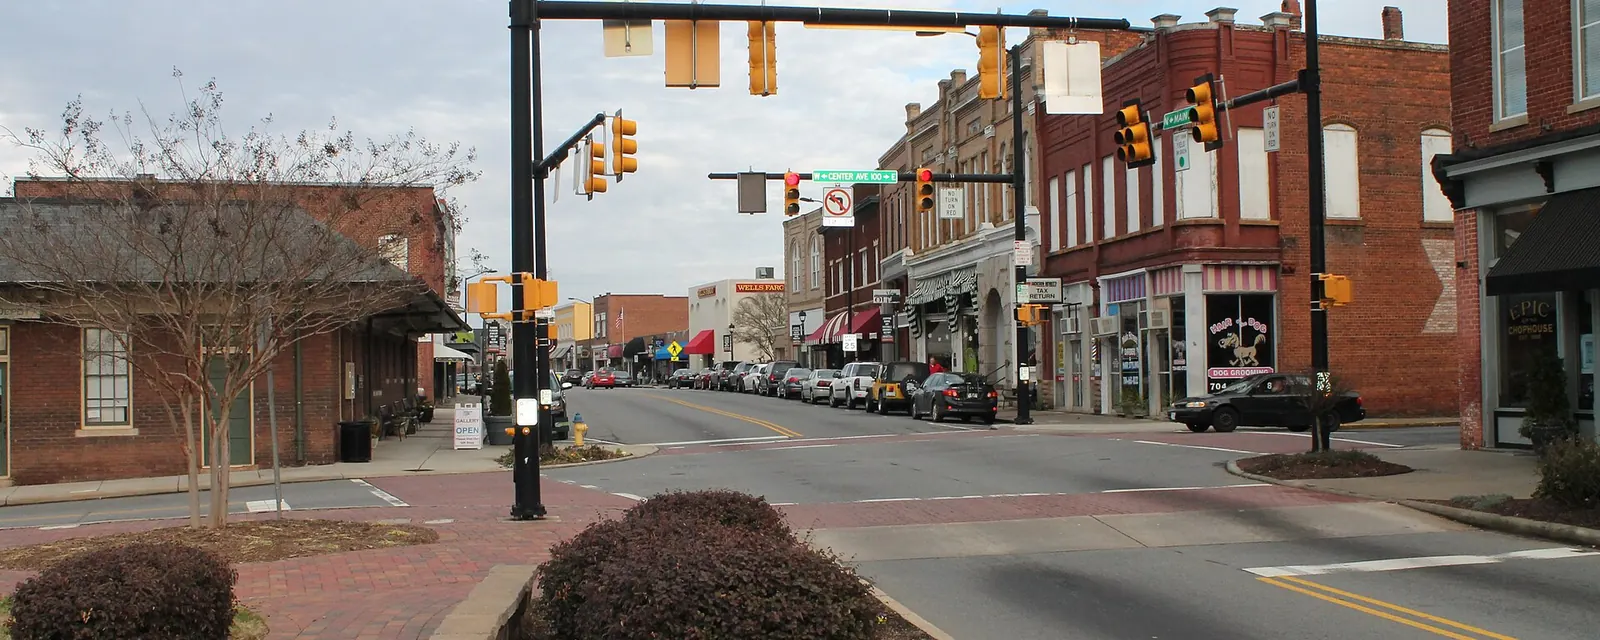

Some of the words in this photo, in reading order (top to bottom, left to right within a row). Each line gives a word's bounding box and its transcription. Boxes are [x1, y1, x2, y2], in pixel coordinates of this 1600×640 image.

[1174, 111, 1188, 121] MAIN
[1267, 111, 1275, 119] NO
[1510, 300, 1550, 320] EPIC
[1210, 318, 1232, 334] HAIR
[1248, 318, 1267, 333] DOG
[1508, 324, 1553, 334] CHOPHOUSE
